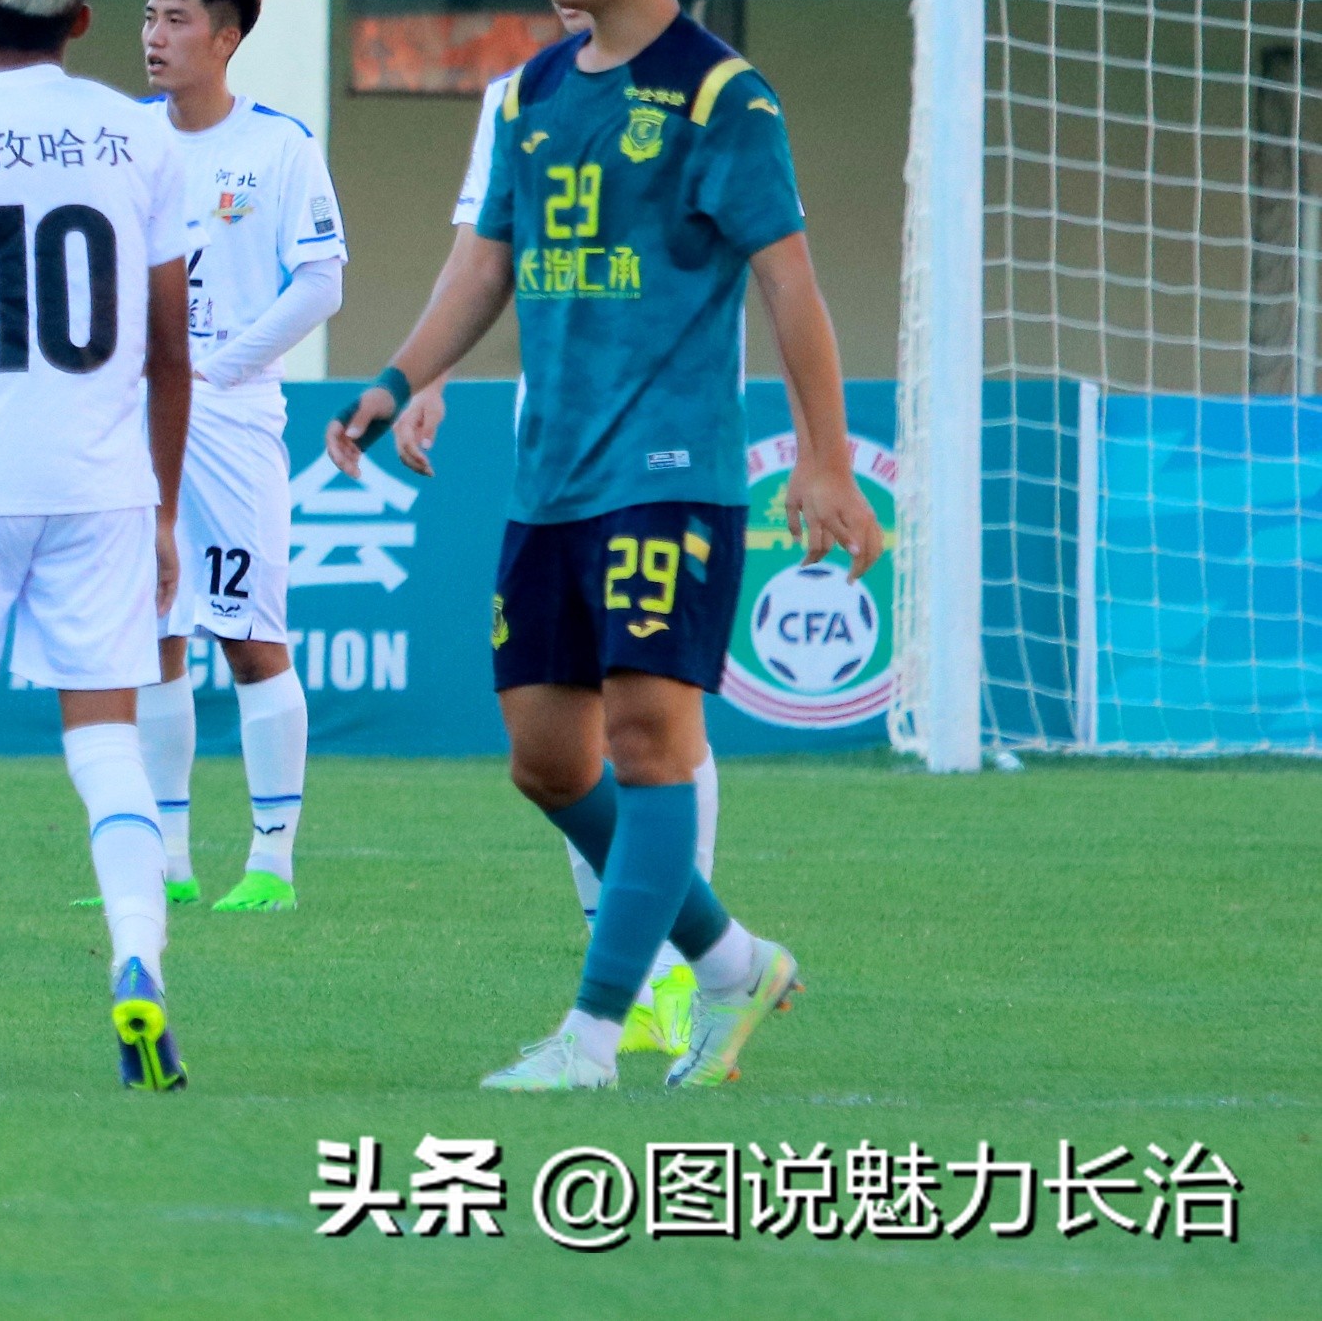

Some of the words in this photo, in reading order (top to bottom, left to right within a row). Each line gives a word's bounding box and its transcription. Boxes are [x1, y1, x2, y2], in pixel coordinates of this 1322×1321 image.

[216, 169, 257, 188] 河北
[545, 164, 602, 239] 29
[204, 546, 251, 599] 12
[604, 537, 680, 615] 29
[779, 612, 854, 645] CFA
